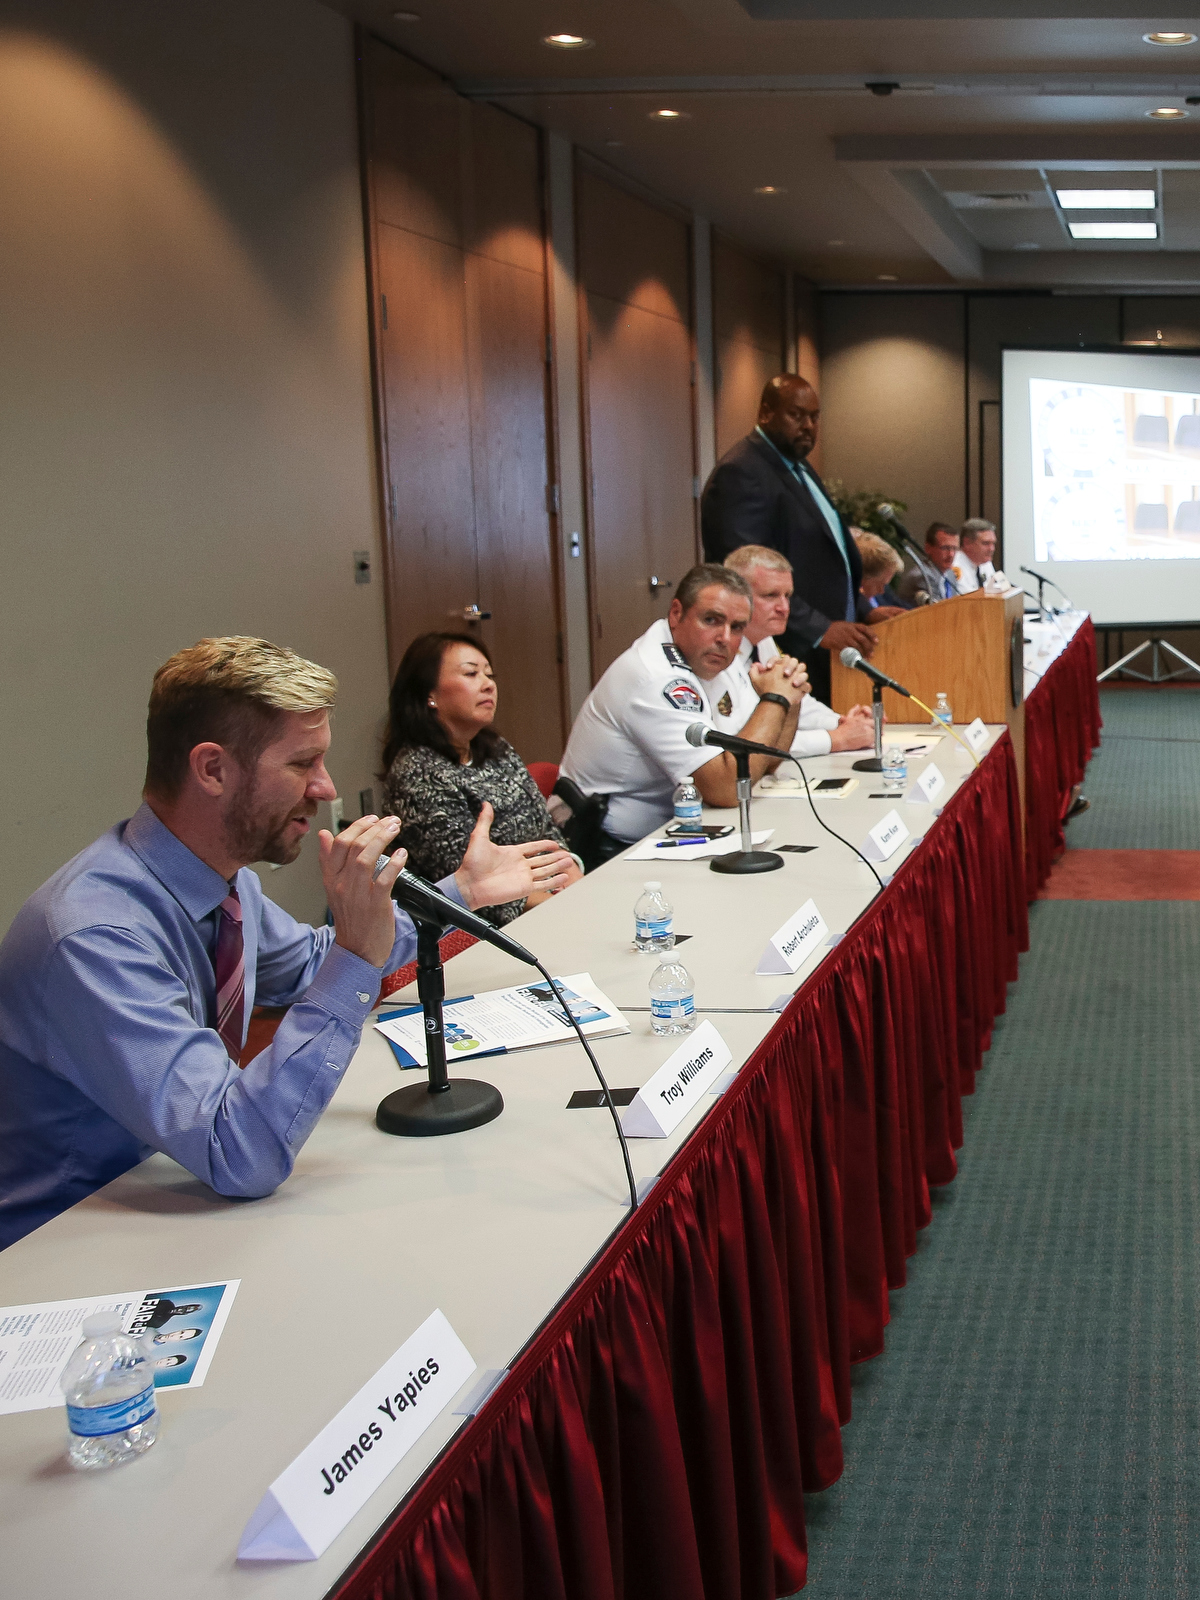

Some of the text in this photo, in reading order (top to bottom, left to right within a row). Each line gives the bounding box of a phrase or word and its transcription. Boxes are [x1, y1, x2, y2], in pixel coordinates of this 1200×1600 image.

[781, 935, 800, 957] Robert
[660, 1047, 713, 1105] Troy Williams
[134, 1298, 160, 1322] FAIR
[321, 1357, 440, 1495] James Yapies
